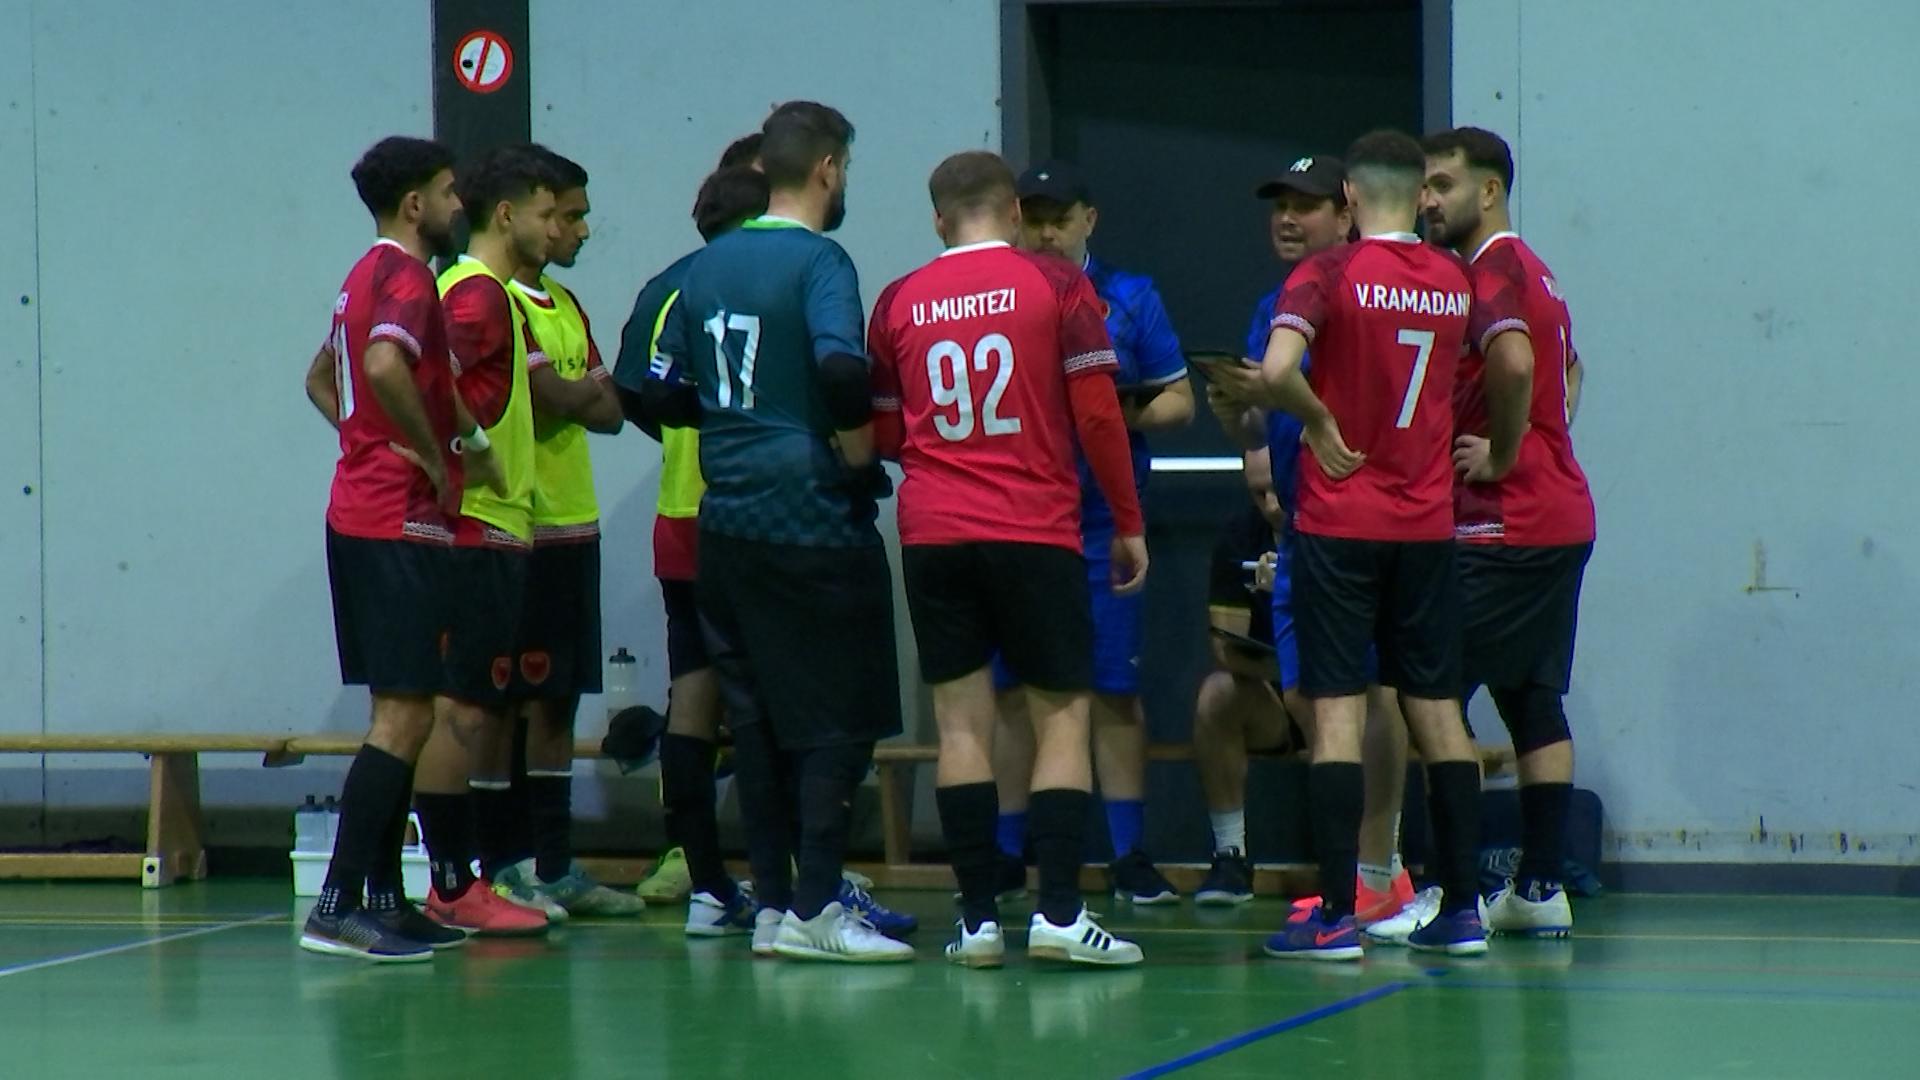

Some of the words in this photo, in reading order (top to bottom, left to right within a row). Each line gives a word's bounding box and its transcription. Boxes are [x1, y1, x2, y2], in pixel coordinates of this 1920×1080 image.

[912, 288, 1016, 327] U.MURTEZI
[703, 309, 760, 410] 17
[926, 332, 1022, 442] 92
[1396, 329, 1436, 428] 7
